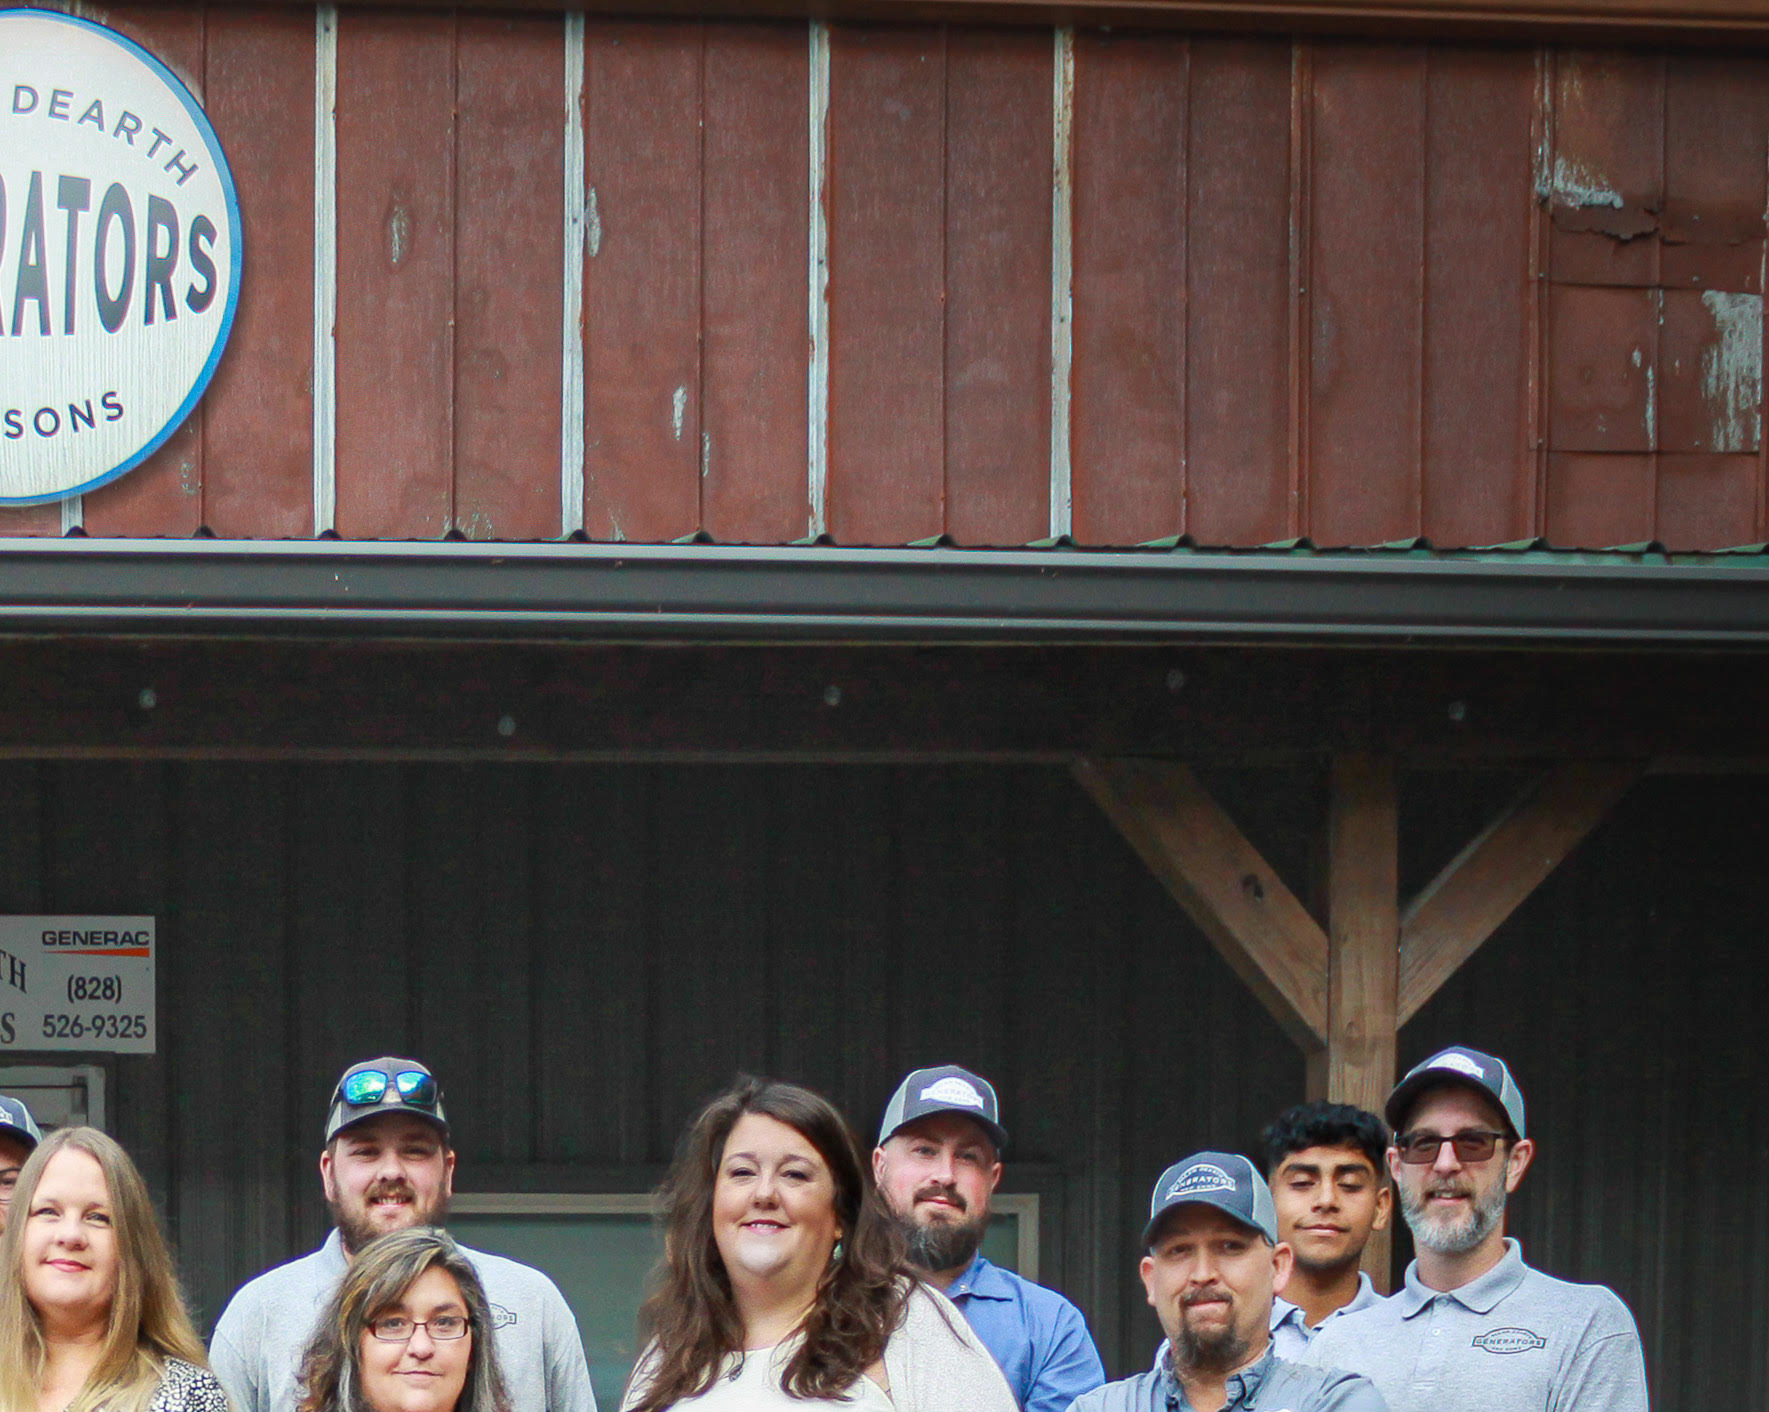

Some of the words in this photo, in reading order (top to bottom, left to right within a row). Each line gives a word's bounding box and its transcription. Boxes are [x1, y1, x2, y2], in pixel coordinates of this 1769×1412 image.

[11, 85, 200, 187] DEARTH
[3, 391, 125, 440] SONS
[41, 930, 150, 946] GENERAC
[67, 974, 122, 1004] (828)
[42, 1014, 148, 1039] 526-9325
